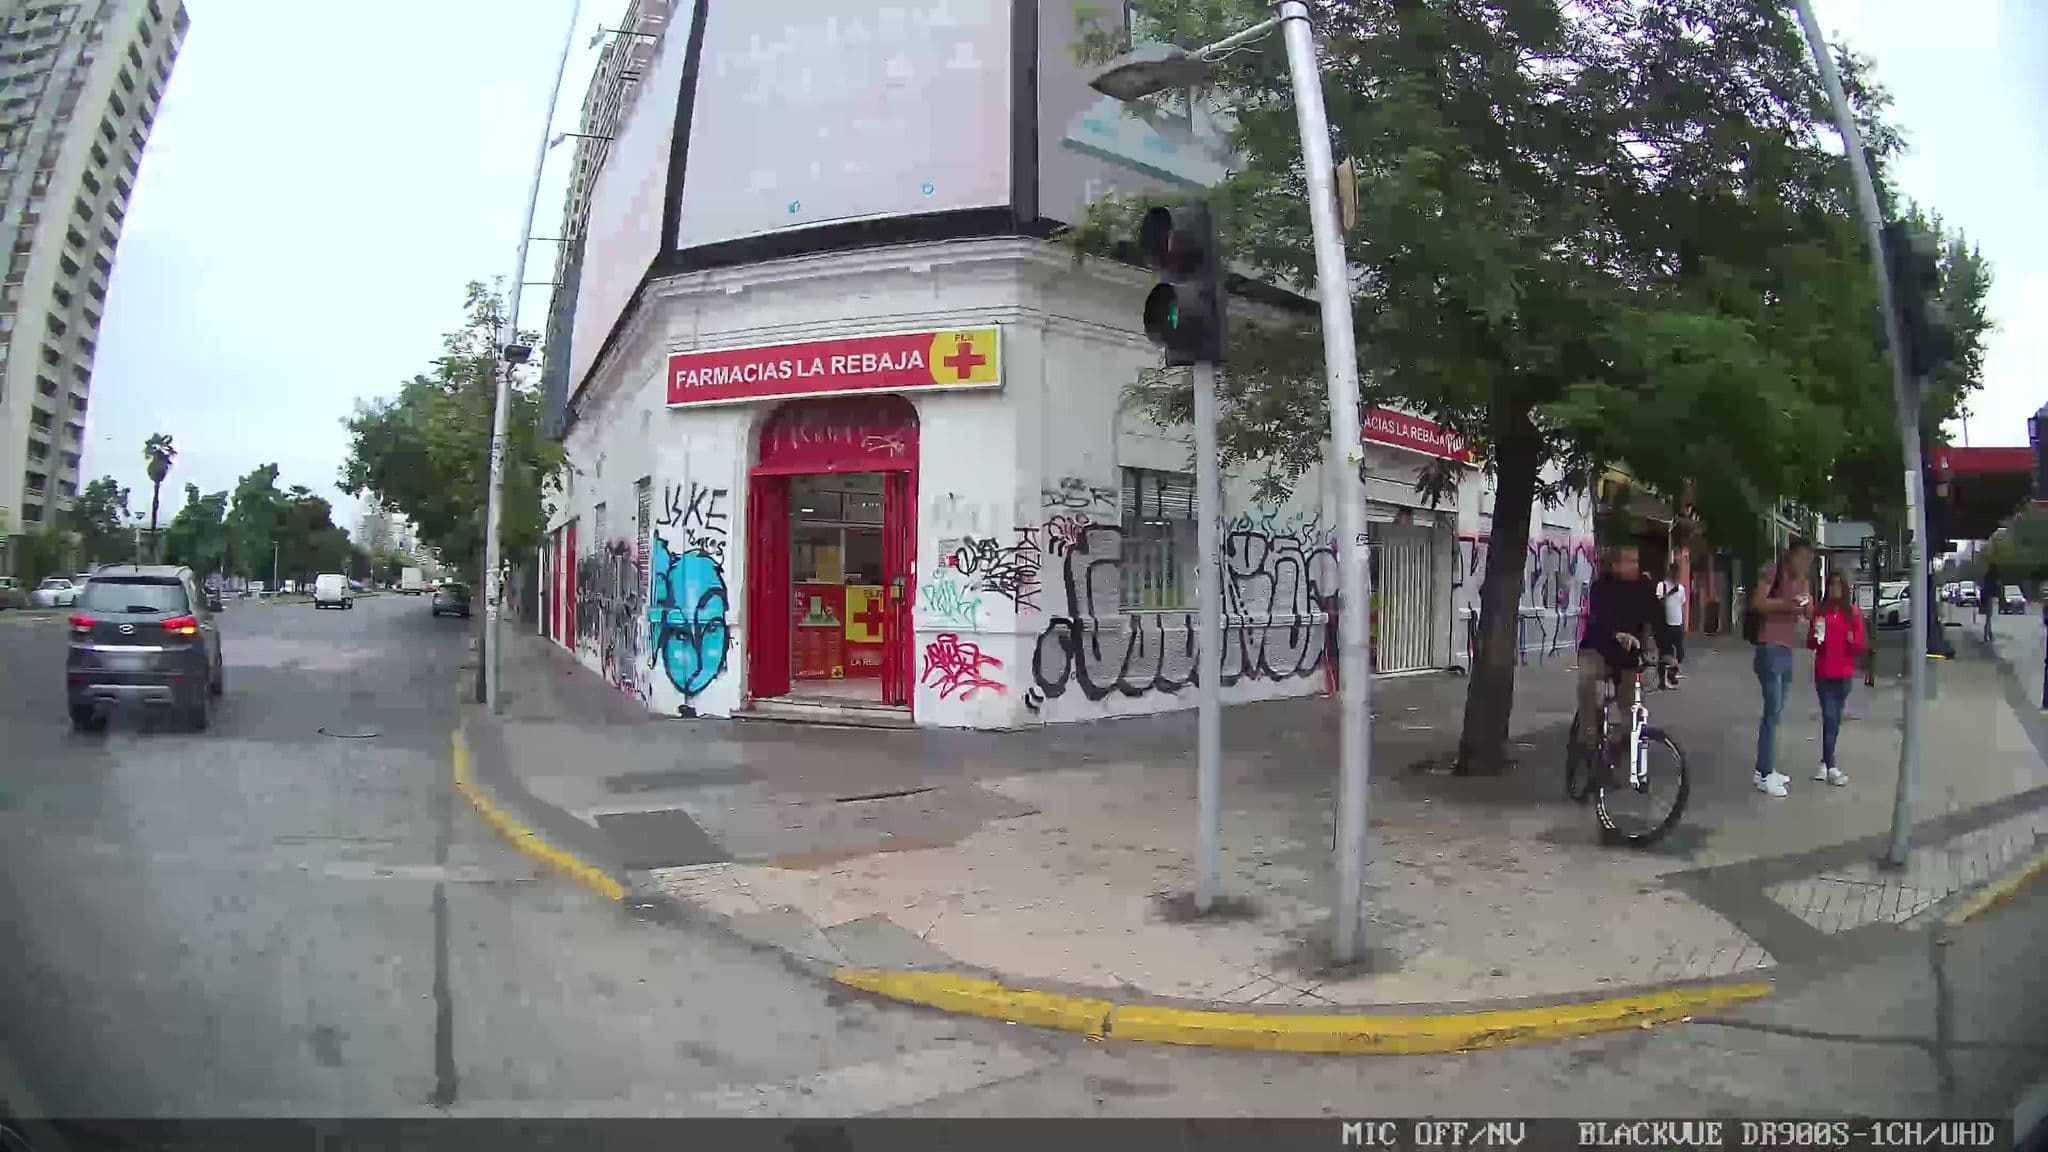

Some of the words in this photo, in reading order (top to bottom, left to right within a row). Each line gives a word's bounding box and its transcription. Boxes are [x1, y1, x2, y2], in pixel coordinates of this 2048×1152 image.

[675, 360, 792, 390] FARMACIAS
[797, 357, 825, 377] LA
[831, 349, 925, 375] REBAJA
[1361, 415, 1395, 434] ACIAS
[1396, 423, 1409, 436] LA
[1411, 427, 1445, 447] REBAJA
